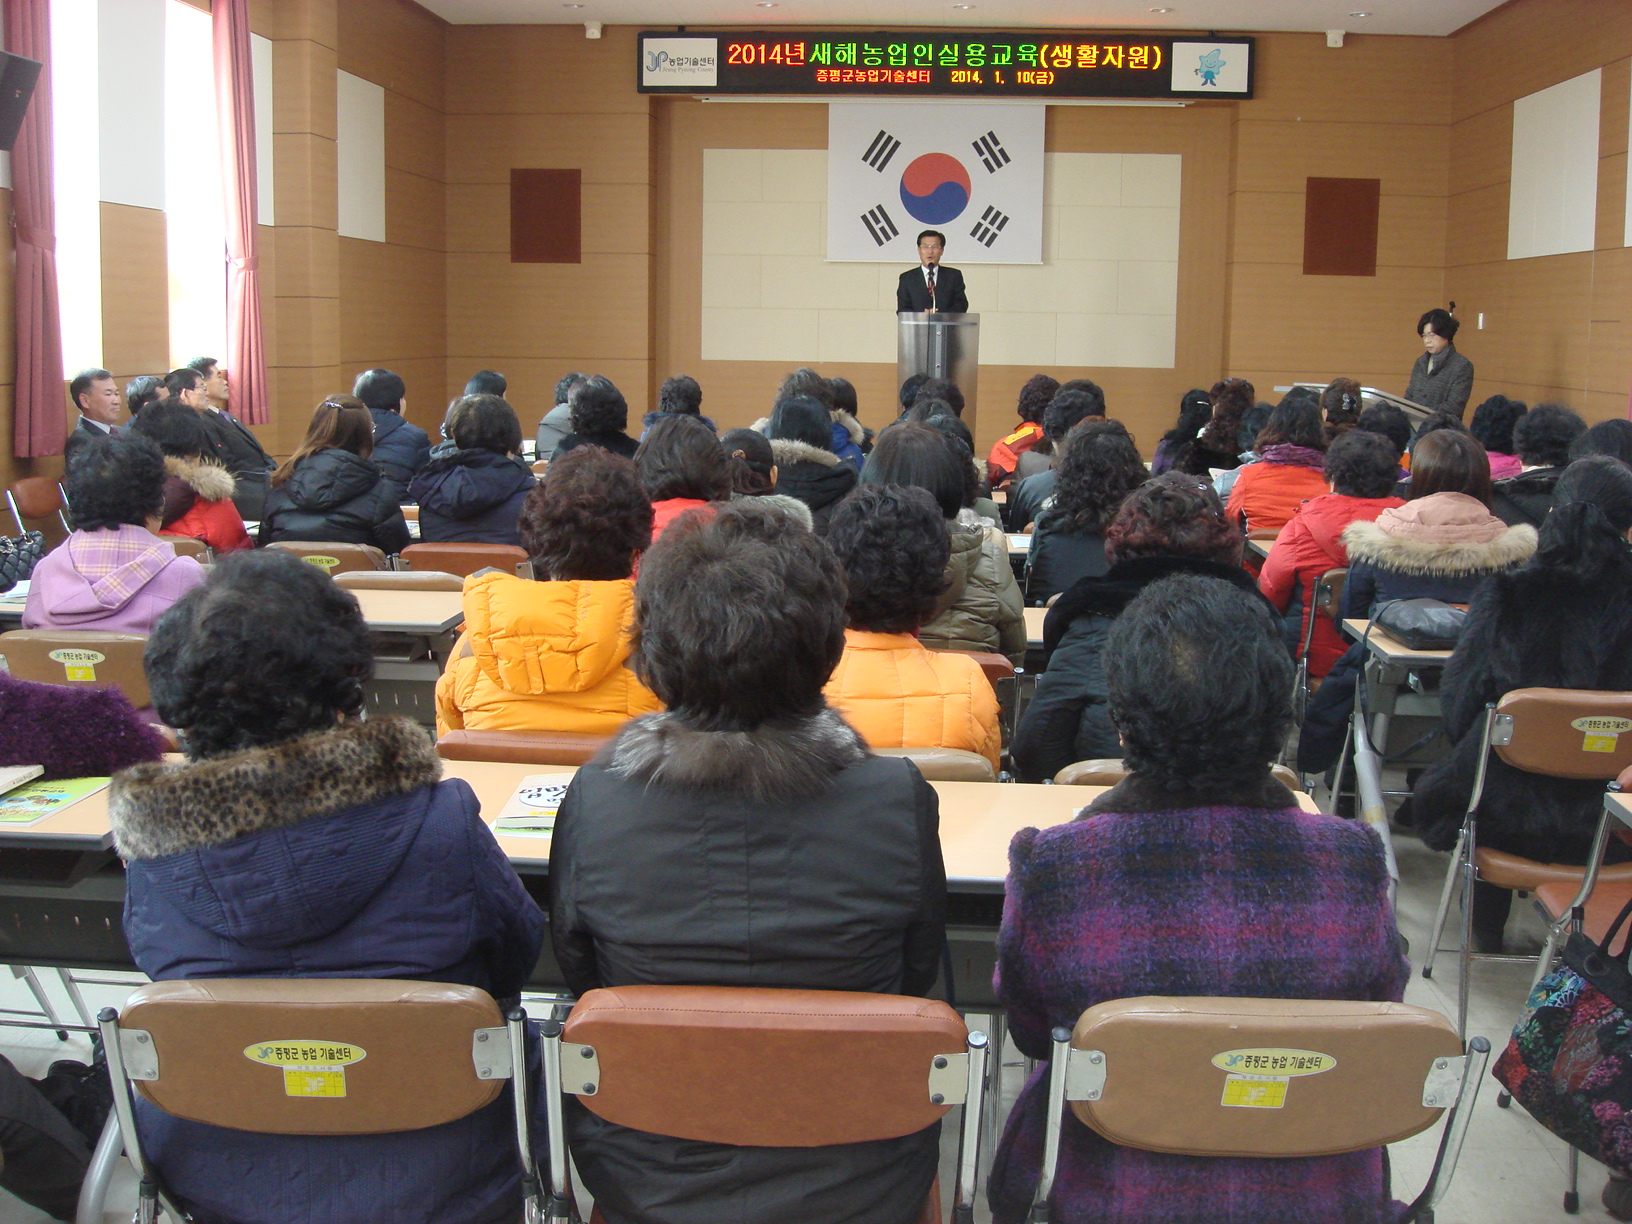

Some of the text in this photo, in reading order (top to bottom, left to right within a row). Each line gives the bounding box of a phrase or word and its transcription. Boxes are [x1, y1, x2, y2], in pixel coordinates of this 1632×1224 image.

[728, 42, 805, 66] 2014년
[669, 57, 715, 67] 농업기술센터
[816, 69, 931, 83] 증평군농업기술센터
[275, 1047, 299, 1060] 증평군
[301, 1048, 317, 1060] 농업
[320, 1047, 352, 1060] 기술센터
[1244, 1055, 1269, 1069] 증평군
[1271, 1056, 1288, 1069] 농업
[1290, 1056, 1323, 1069] 기술센터
